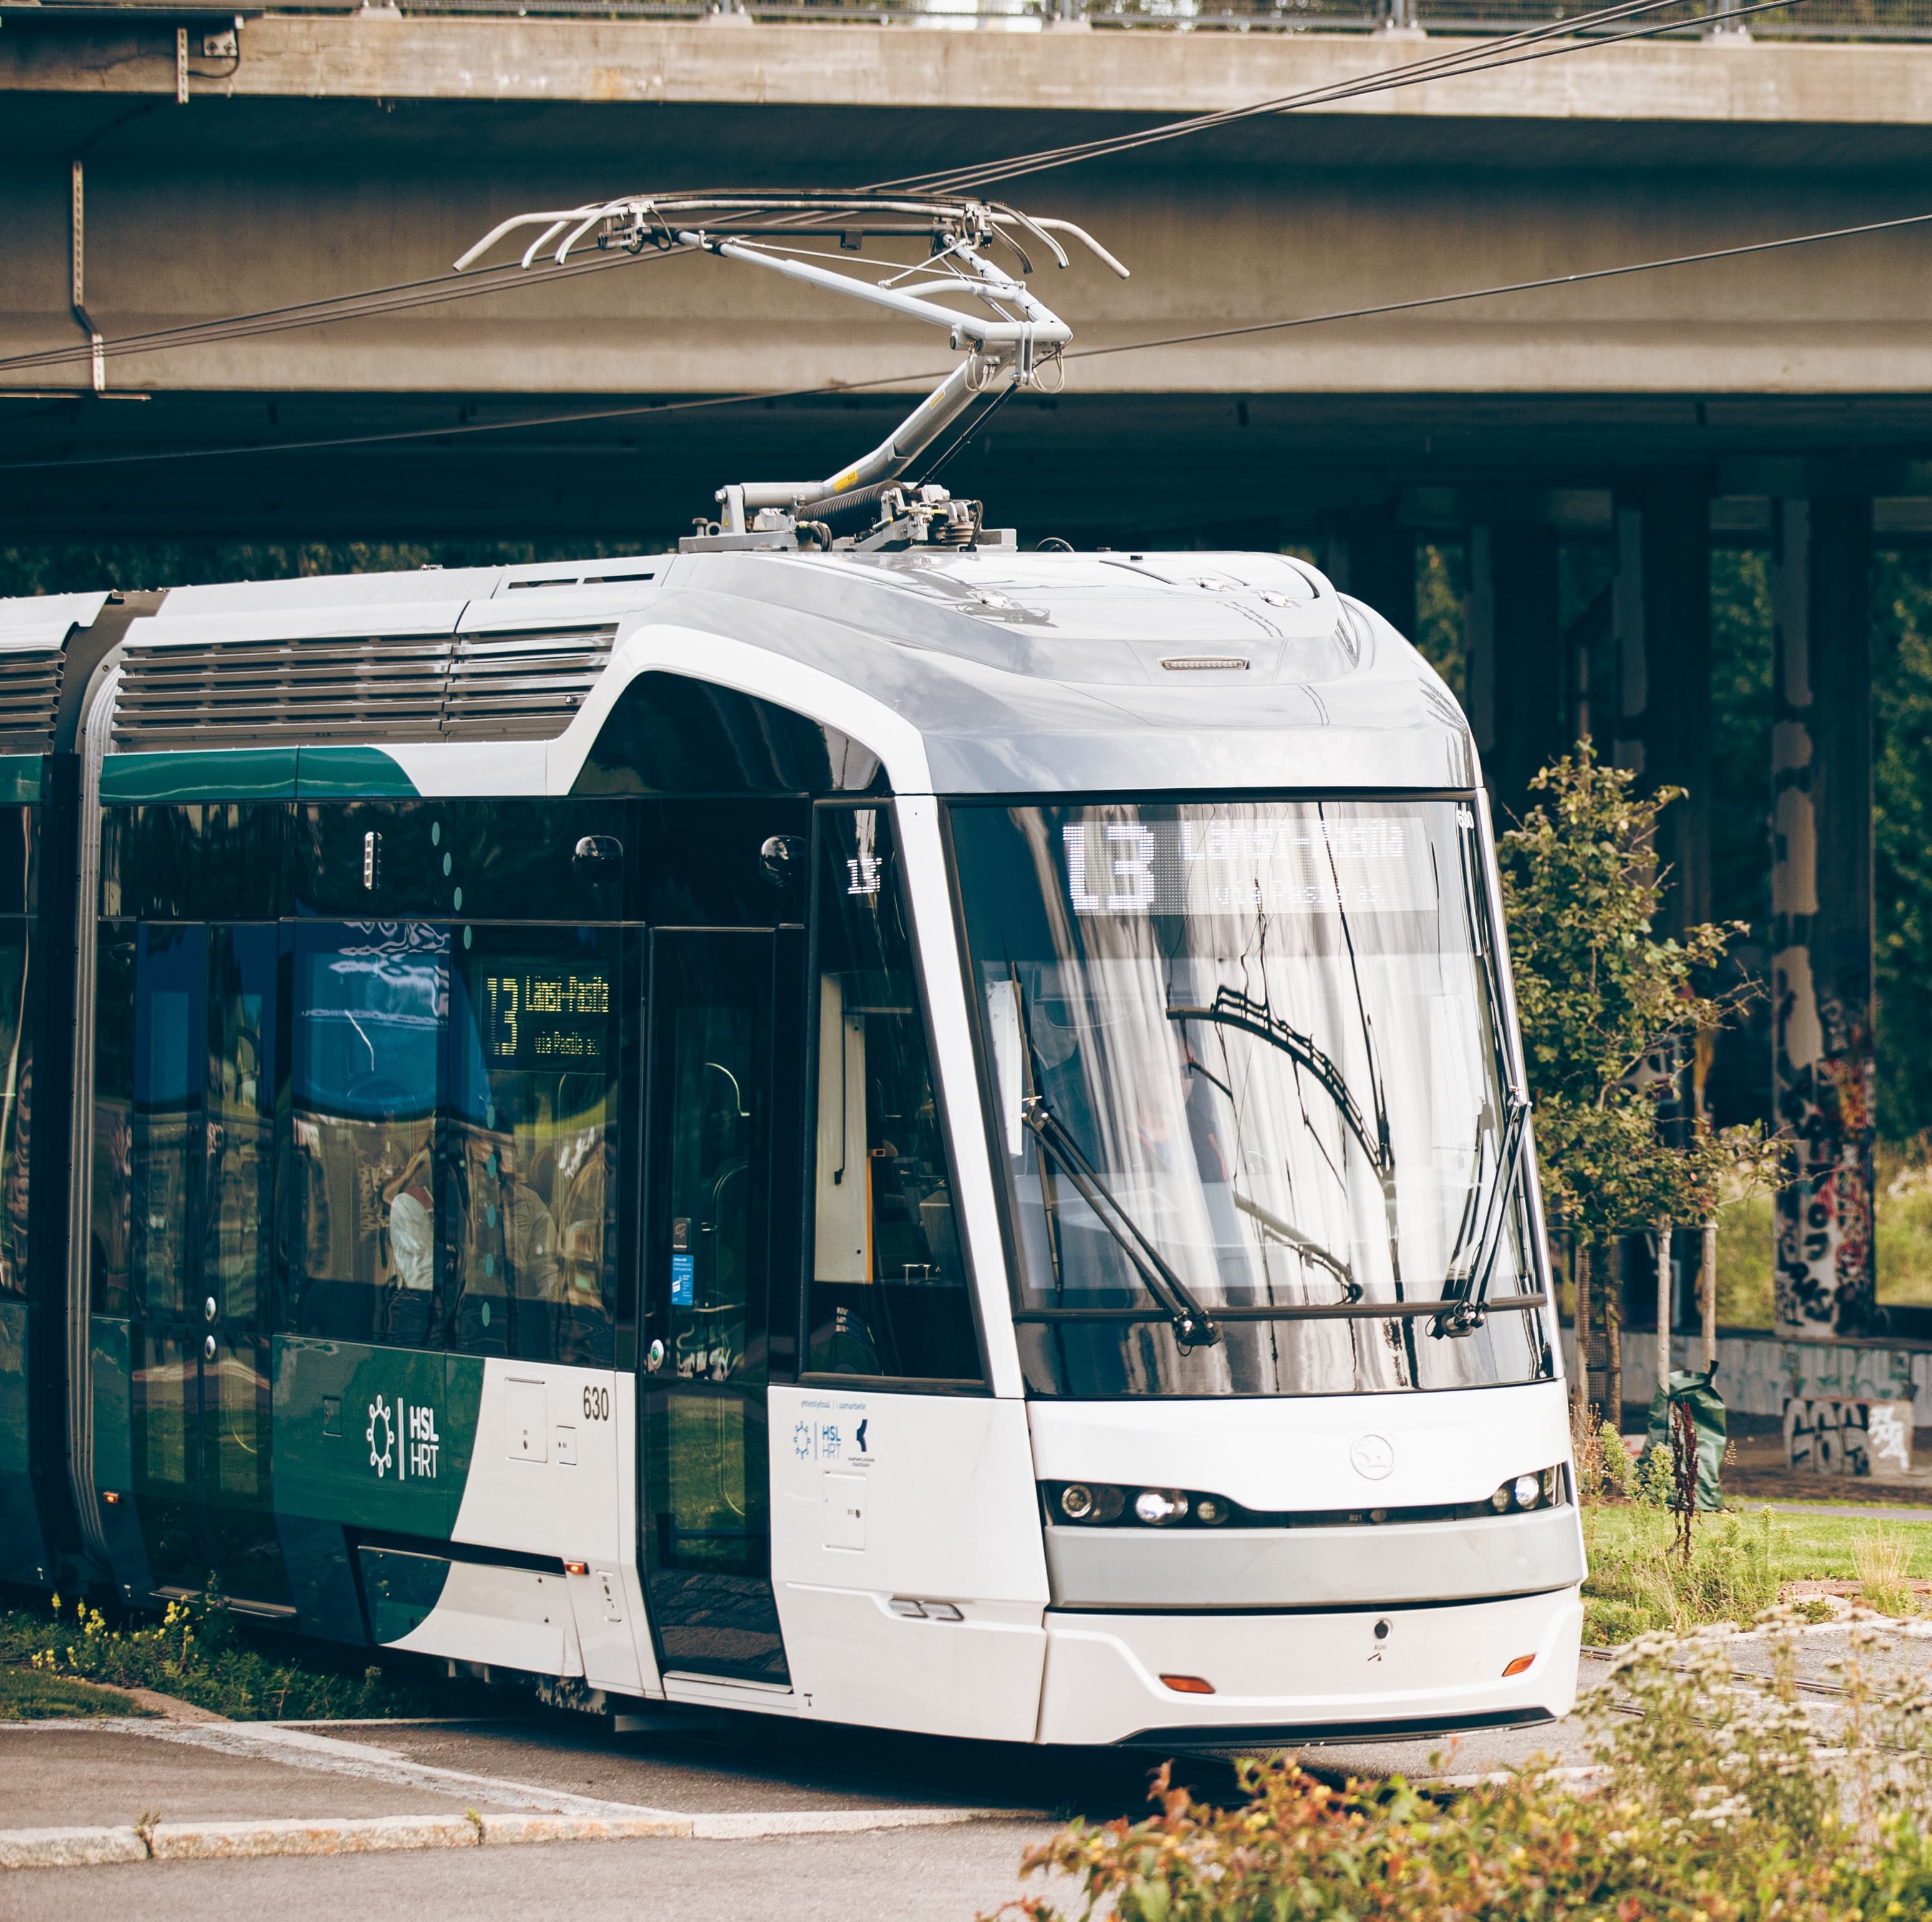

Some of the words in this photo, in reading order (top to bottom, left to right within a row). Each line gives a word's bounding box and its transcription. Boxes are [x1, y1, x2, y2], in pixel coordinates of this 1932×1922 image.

[1456, 809, 1474, 829] 630
[1062, 824, 1155, 910] 13
[487, 978, 518, 1056] 13
[583, 1385, 609, 1421] 630
[409, 1405, 439, 1442] HSL
[822, 1424, 841, 1442] HSL
[410, 1442, 439, 1479] HRT
[823, 1443, 841, 1459] HRT
